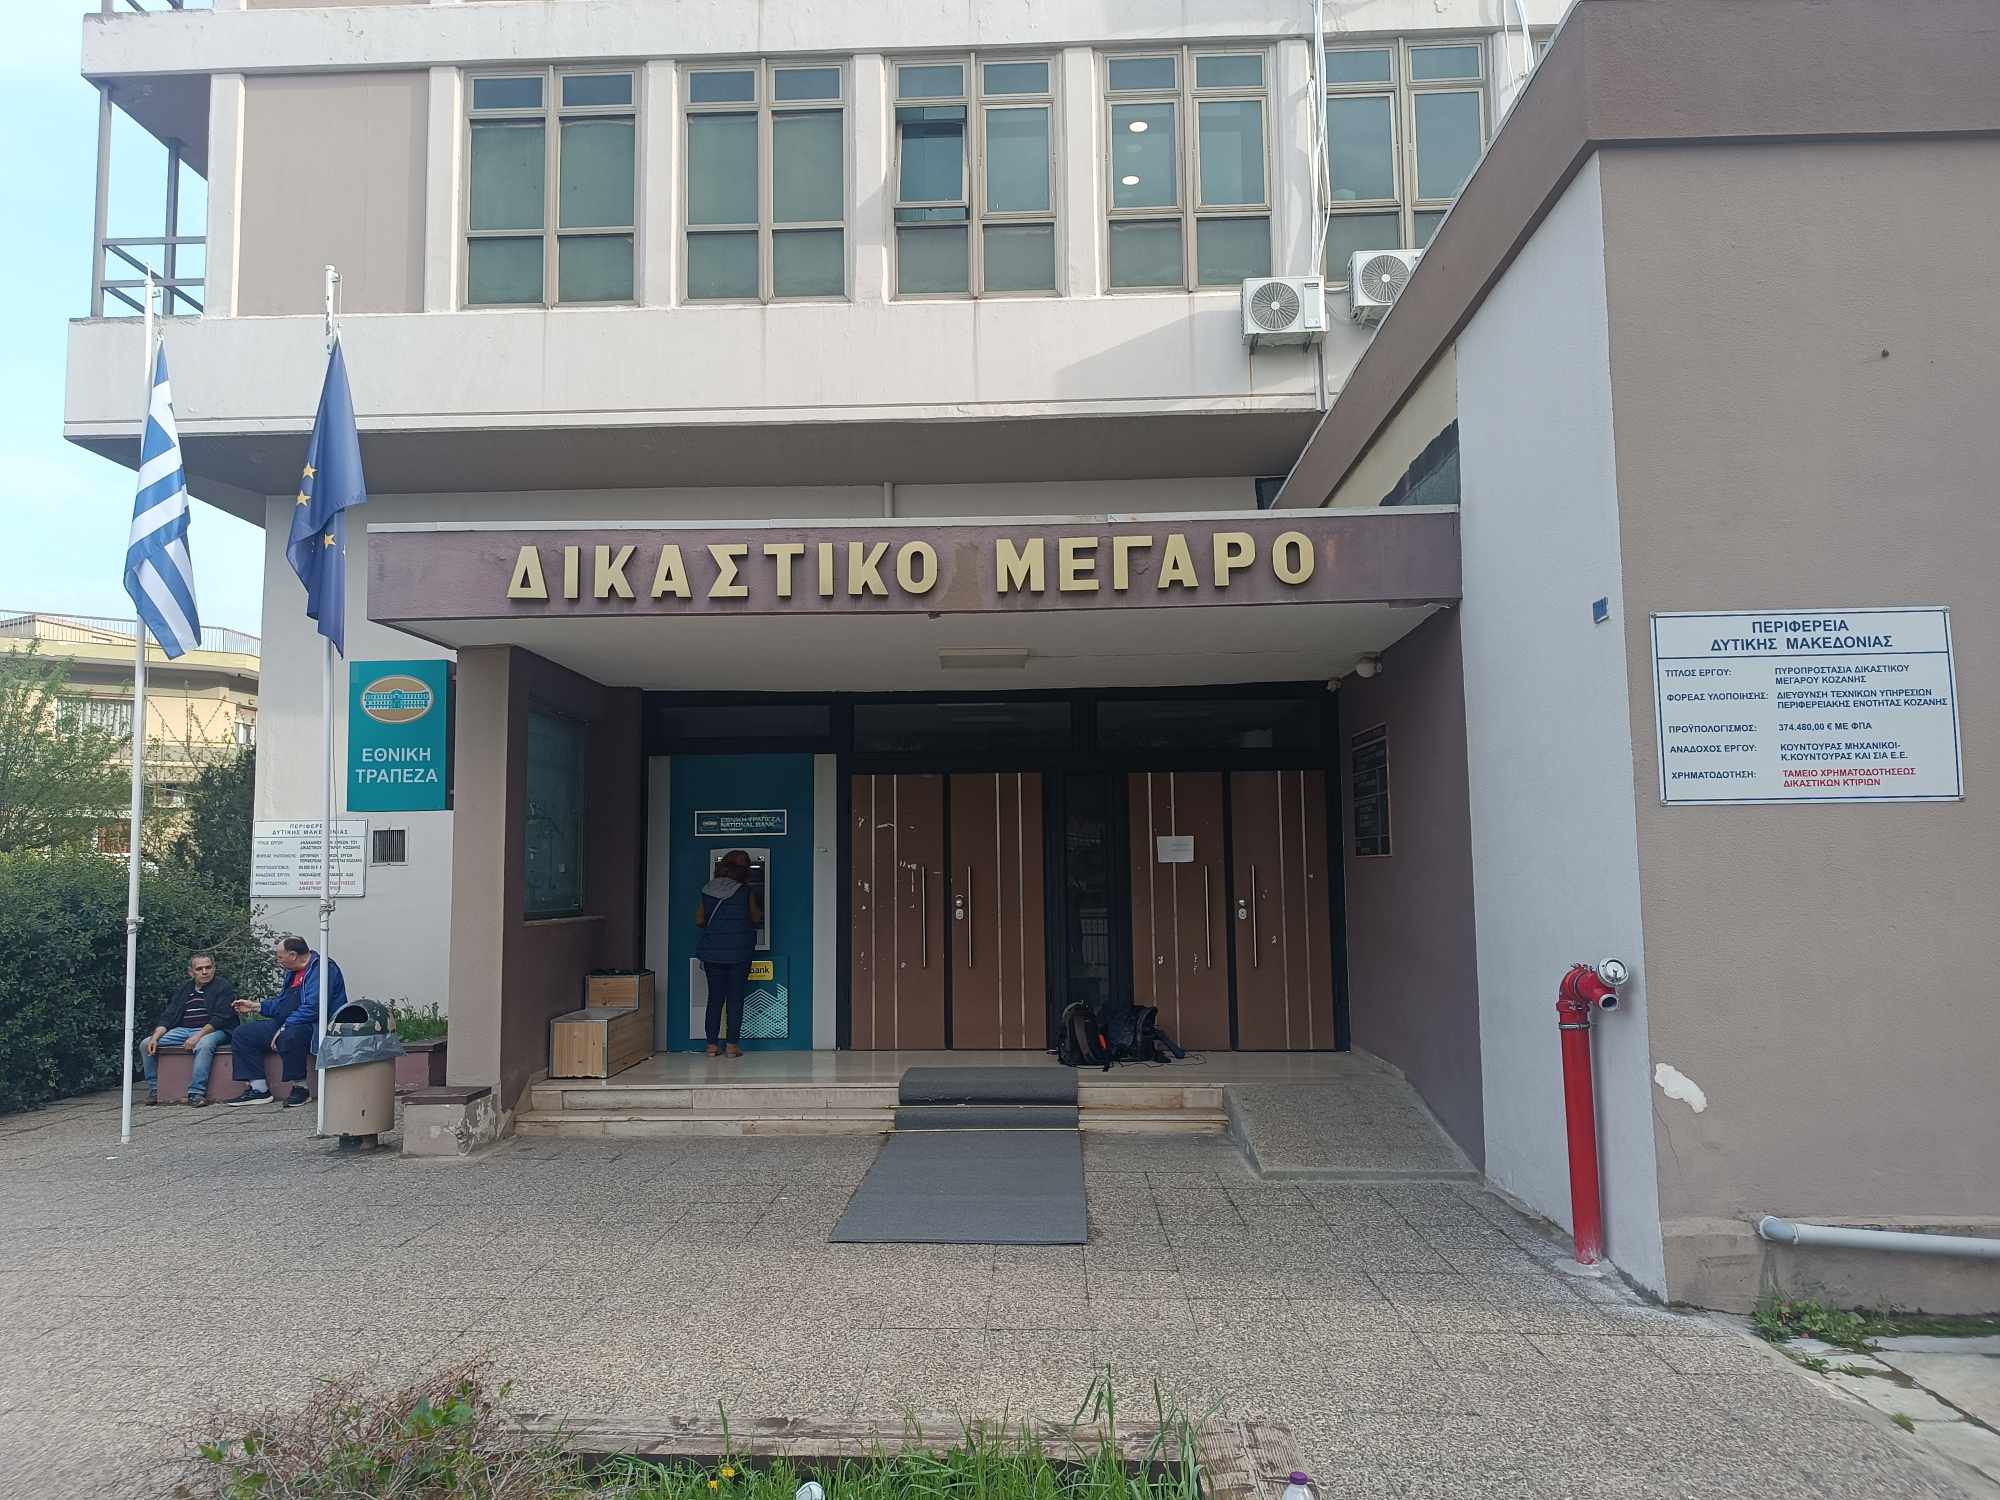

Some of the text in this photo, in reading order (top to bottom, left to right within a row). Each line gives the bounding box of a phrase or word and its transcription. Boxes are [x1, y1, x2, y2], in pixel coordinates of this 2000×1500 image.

[506, 531, 1315, 599] ΔΙΚΑΣΤΙΚΟ ΜΕΓΑΡΟ
[1751, 619, 1849, 634] ΠΕΡΙΦΕΡΕΙΑ
[1711, 635, 1893, 651] ΔΥΤΙΚΗΣ ΜΑΚΕΔΟΝΙΑΣ
[1665, 668, 1732, 677] ΤΙΤΛΟΣ ΕΡΓΟΥ:
[1775, 665, 1910, 675] ΠΥΡΟΠΡΟΣΤΑΣΙΑ ΔΙΚΑΣΤΙΚΟΥ
[1775, 675, 1867, 685] ΜΕΓΑΡΟΥ ΚΟΖΑΝΗΣ
[1667, 692, 1768, 702] ΦΟΡΕΑΣ ΥΛΟΠΟΙΗΣΗΣ:
[1777, 688, 1932, 699] ΔΙΕΥΘΥΝΣΗ ΤΕΧΝΙΚΩΝ ΥΠΗΡΕΣΙΩΝ
[1777, 698, 1948, 709] ΠΕΡΙΦΕΡΕΙΑΚΗΣ ΕΝΟΤΗΤΑΣ ΚΟΖΑΝΗΣ
[1826, 722, 1833, 731] €
[1834, 722, 1848, 731] ΜΕ
[1851, 721, 1873, 730] ΦΠΑ
[1670, 744, 1757, 754] ΑΝΑΔΟΧΟΣ ΕΡΓΟΥ:
[1780, 743, 1843, 752] ΚΟΥΝΤΟΥΡΑΣ
[361, 747, 431, 762] ΕΘΝΙΚΗ
[1781, 752, 1853, 761] Κ.ΚΟΥΝΤΟΥΡΑΣ
[1855, 752, 1871, 760] ΚΑΙ
[1873, 751, 1888, 760] ΣΙΑ
[355, 768, 438, 783] ΤΡΑΠΕΖΑ
[1672, 770, 1757, 780] ΧΡΗΜΑΤΟΔΟΤΗΣΗ:
[1782, 767, 1917, 778] ΤΑΜΕΙΟ ΧΡΗΜΑΤΟΔΟΤΗΣΕΩΣ
[1783, 778, 1881, 788] ΔΙΚΑΣΤΙΚΩΝ ΚΤΙΡΙΩΝ
